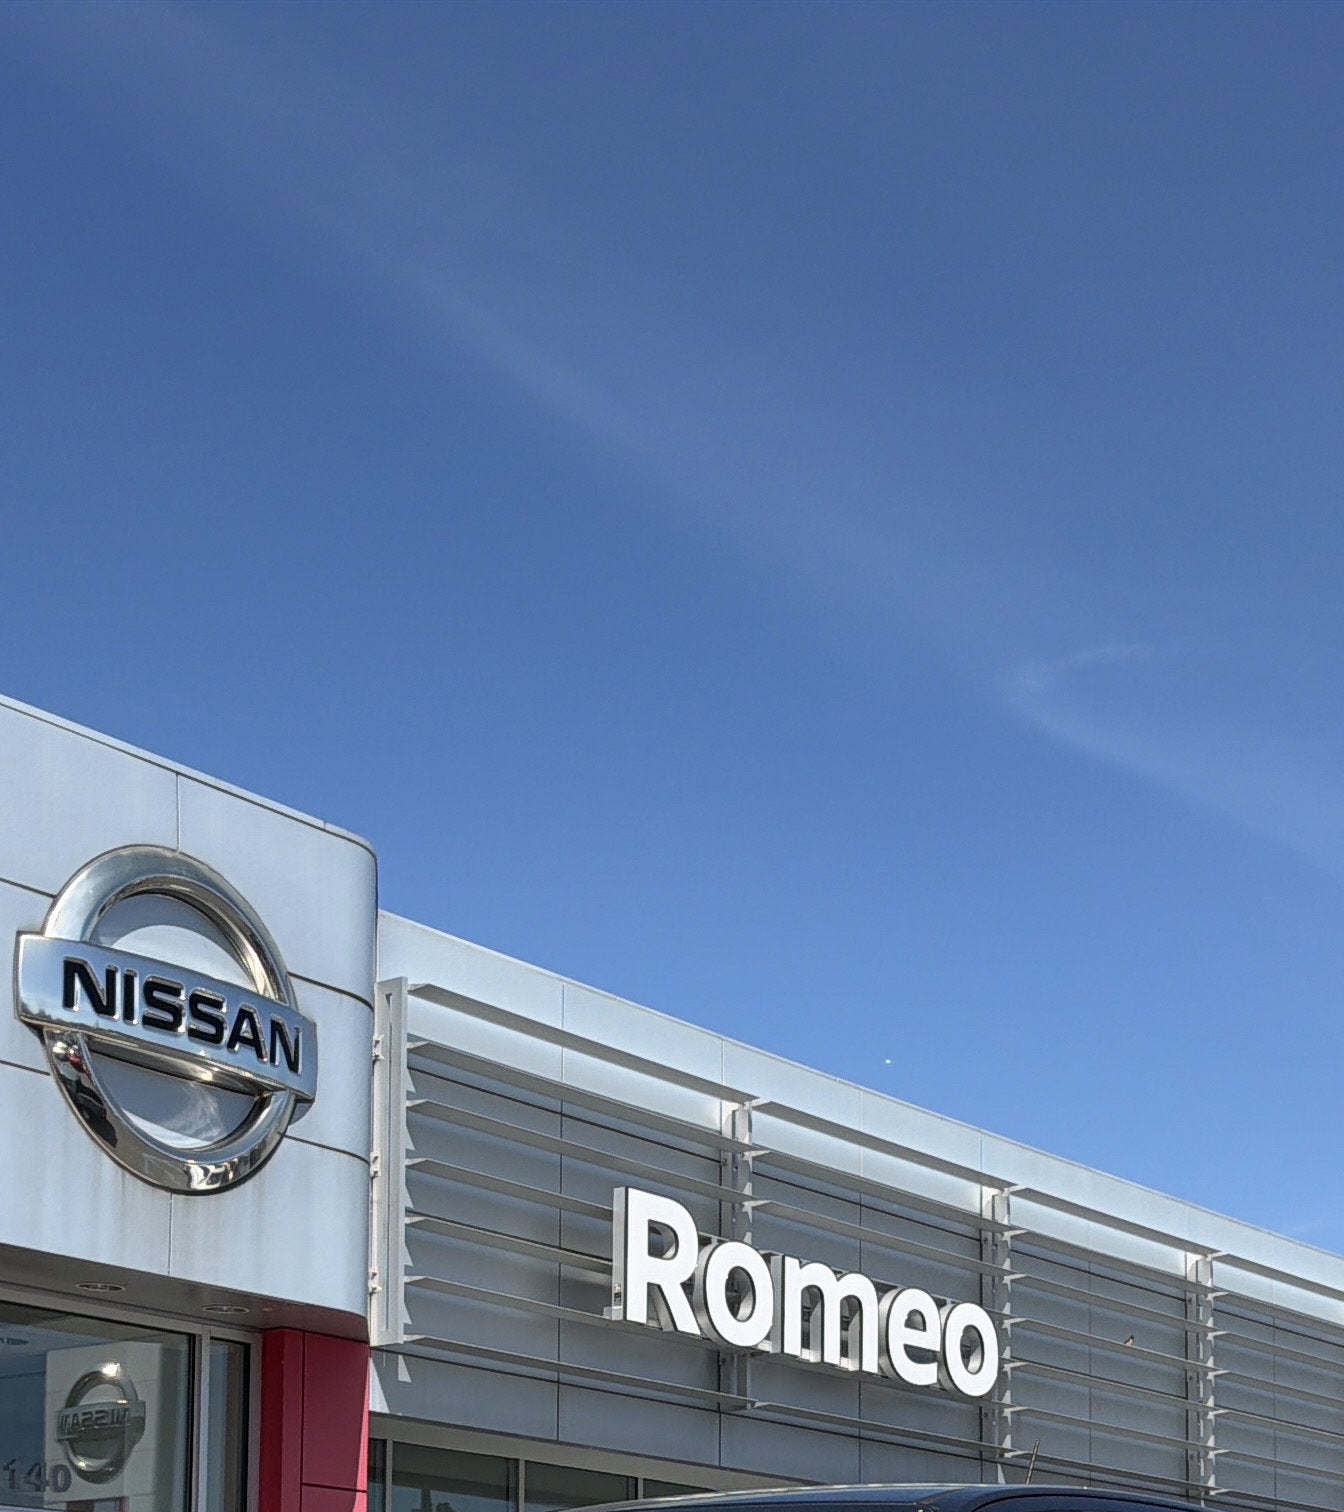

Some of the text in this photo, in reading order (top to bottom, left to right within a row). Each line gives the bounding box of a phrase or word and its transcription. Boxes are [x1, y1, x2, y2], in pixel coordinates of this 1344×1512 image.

[63, 956, 303, 1076] NISSAN
[616, 1186, 999, 1397] Romeo
[3, 1458, 72, 1492] 140
